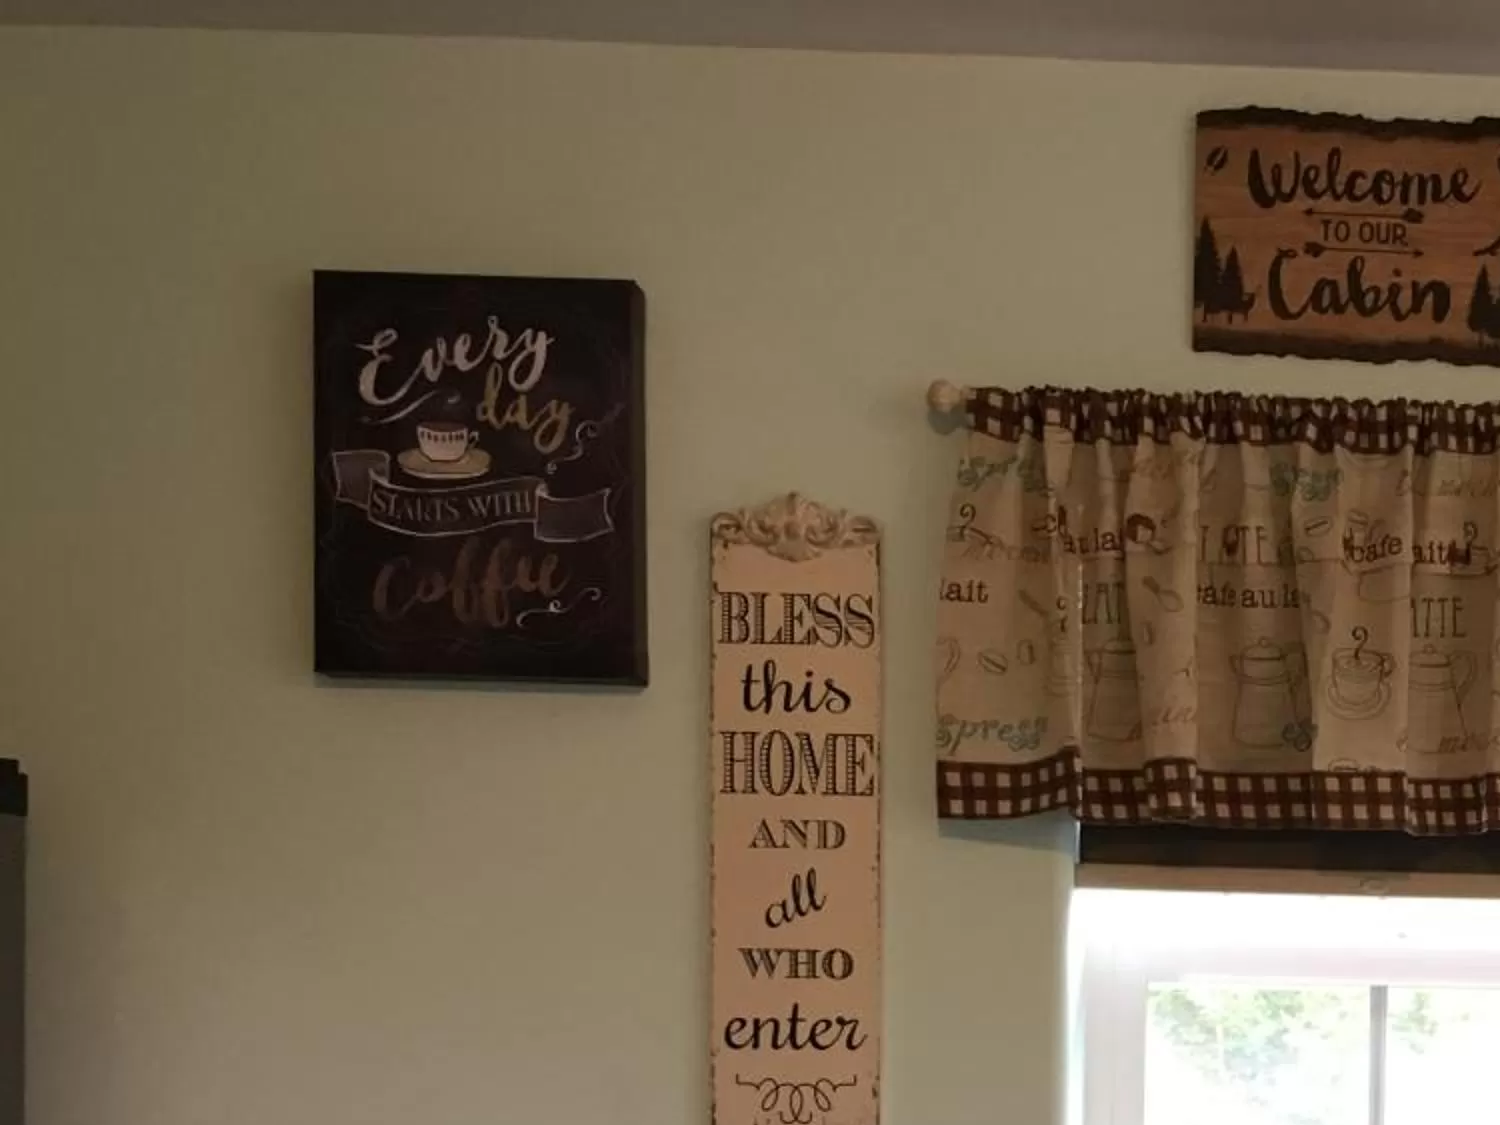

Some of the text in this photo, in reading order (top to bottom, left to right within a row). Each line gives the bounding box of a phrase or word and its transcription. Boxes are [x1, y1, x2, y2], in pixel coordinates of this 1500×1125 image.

[1248, 147, 1482, 208] Welcome
[1321, 219, 1409, 247] TO OUR
[1268, 249, 1451, 322] Cabin
[356, 316, 554, 405] Every
[477, 363, 574, 453] day
[373, 490, 532, 522] STARTS WITH
[373, 536, 570, 627] Coffee
[717, 591, 876, 648] BLESS
[741, 659, 853, 714] this
[719, 730, 876, 797] HOME
[748, 818, 847, 851] AND
[765, 867, 827, 929] all
[739, 947, 855, 980] WHO
[723, 1003, 869, 1052] enter
